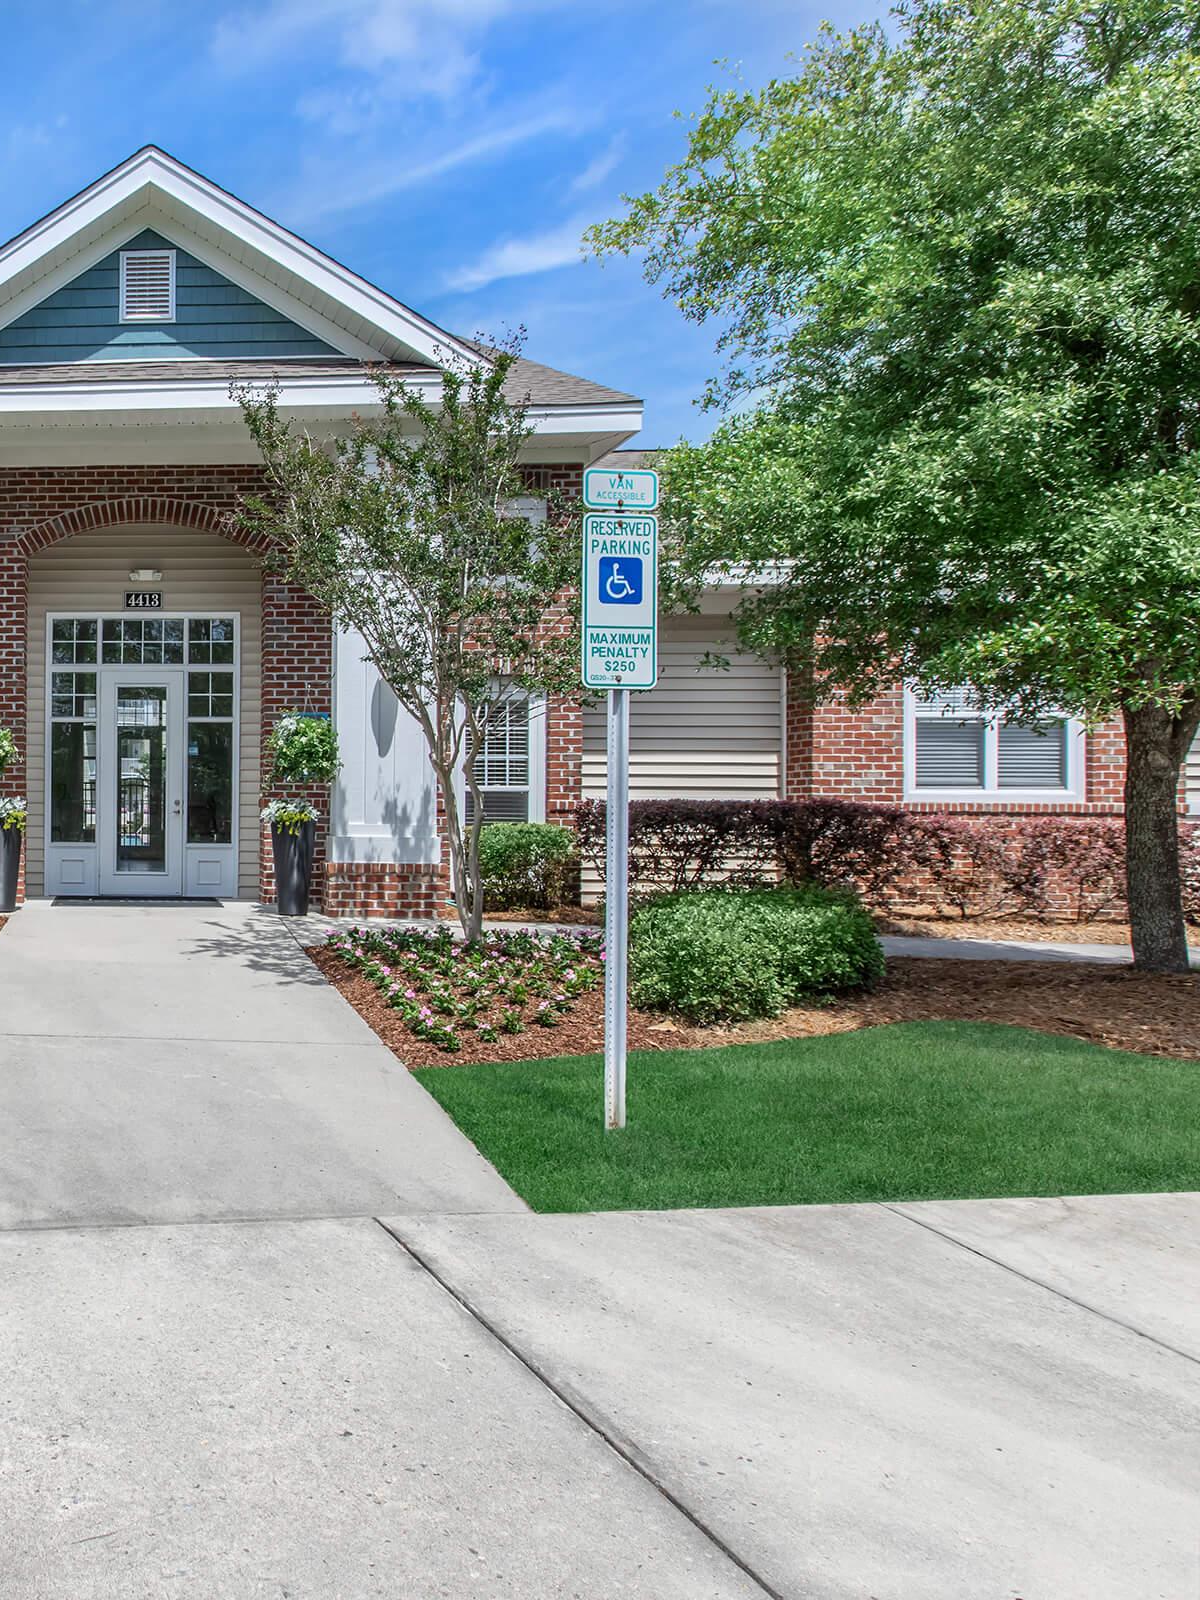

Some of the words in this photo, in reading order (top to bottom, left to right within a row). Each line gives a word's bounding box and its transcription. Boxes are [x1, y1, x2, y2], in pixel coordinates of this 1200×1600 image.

[608, 478, 634, 490] VAN
[596, 490, 646, 501] ACCESSIBLE
[591, 520, 651, 538] RESERVED
[591, 539, 651, 556] PARKING
[128, 593, 160, 607] 4413
[590, 632, 651, 645] MAXIMUM
[591, 646, 649, 659] PENALTY
[604, 660, 636, 672] $250
